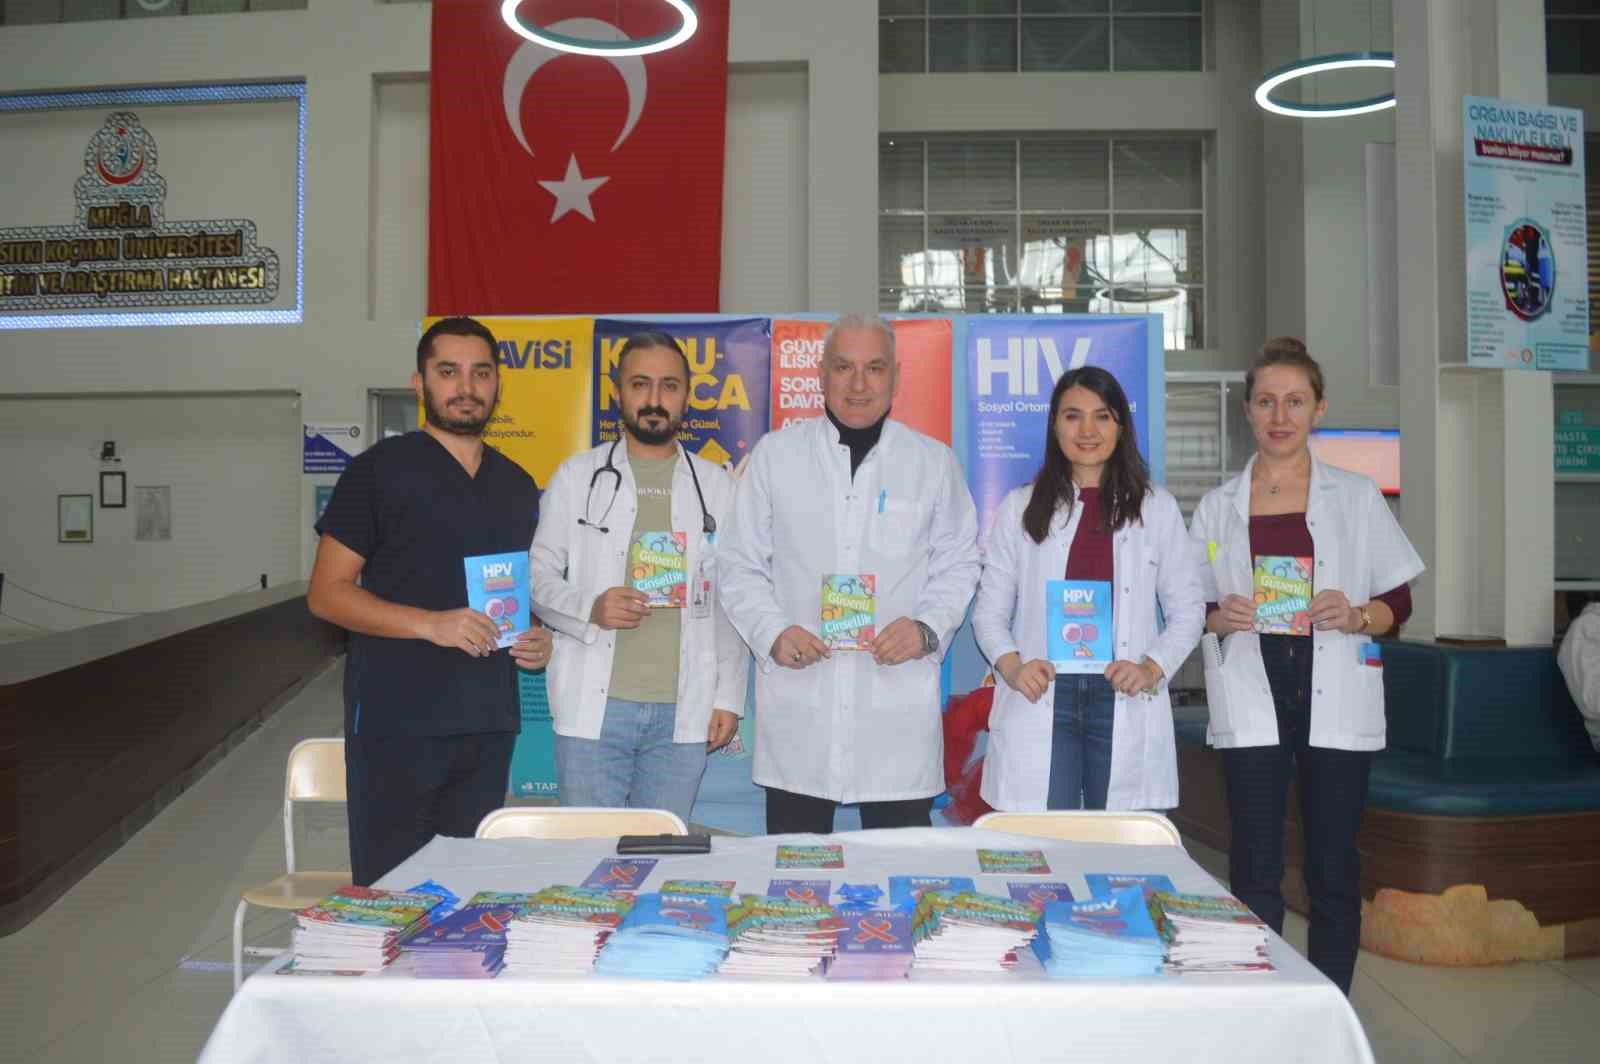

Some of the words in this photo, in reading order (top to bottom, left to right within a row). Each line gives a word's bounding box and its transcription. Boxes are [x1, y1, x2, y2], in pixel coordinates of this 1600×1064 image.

[89, 202, 151, 227] MUĞLA
[167, 263, 266, 291] HASTANESİ
[977, 338, 1092, 396] HIV
[977, 401, 1014, 414] Sosyal
[482, 563, 513, 577] HPV
[1063, 589, 1095, 602] HPV
[1072, 899, 1118, 912] HPV
